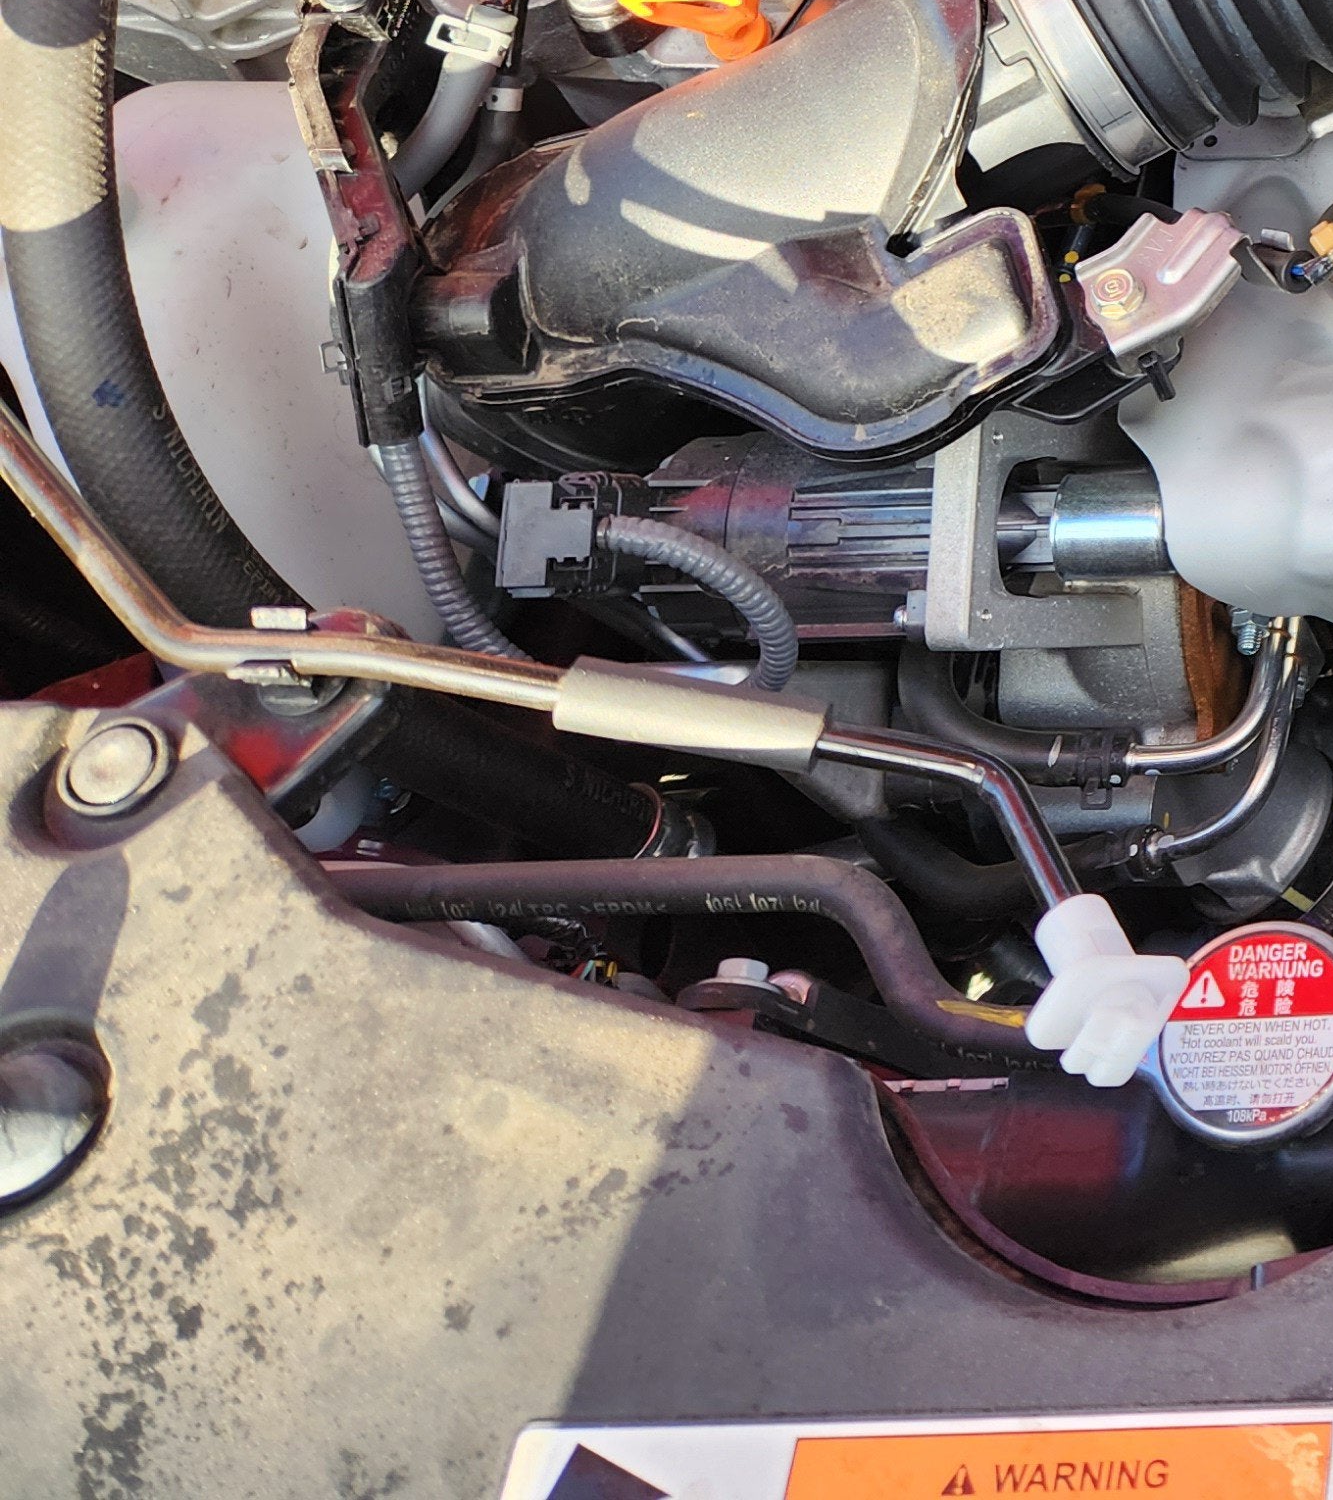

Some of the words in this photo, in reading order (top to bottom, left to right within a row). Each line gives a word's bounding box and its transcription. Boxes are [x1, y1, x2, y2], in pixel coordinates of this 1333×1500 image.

[1229, 942, 1308, 963] DANGER
[1228, 959, 1324, 980] WARNUNG
[1184, 1022, 1225, 1036] NEVER
[1228, 1021, 1262, 1035] OPEN
[1264, 1020, 1301, 1034] WHEN
[1182, 1037, 1201, 1049] Hot
[1204, 1036, 1242, 1048] coolant
[1245, 1035, 1262, 1047] will
[1264, 1034, 1292, 1046] scald
[1230, 1050, 1251, 1063] PAS
[1254, 1049, 1294, 1061] QUAND
[1173, 1066, 1199, 1080] NICHT
[1201, 1065, 1217, 1078] BEI
[1219, 1064, 1259, 1078] HEISSEM
[1260, 1063, 1293, 1076] MOTOR
[1227, 1109, 1267, 1123] 108kPa
[994, 1458, 1171, 1493] WARNING
